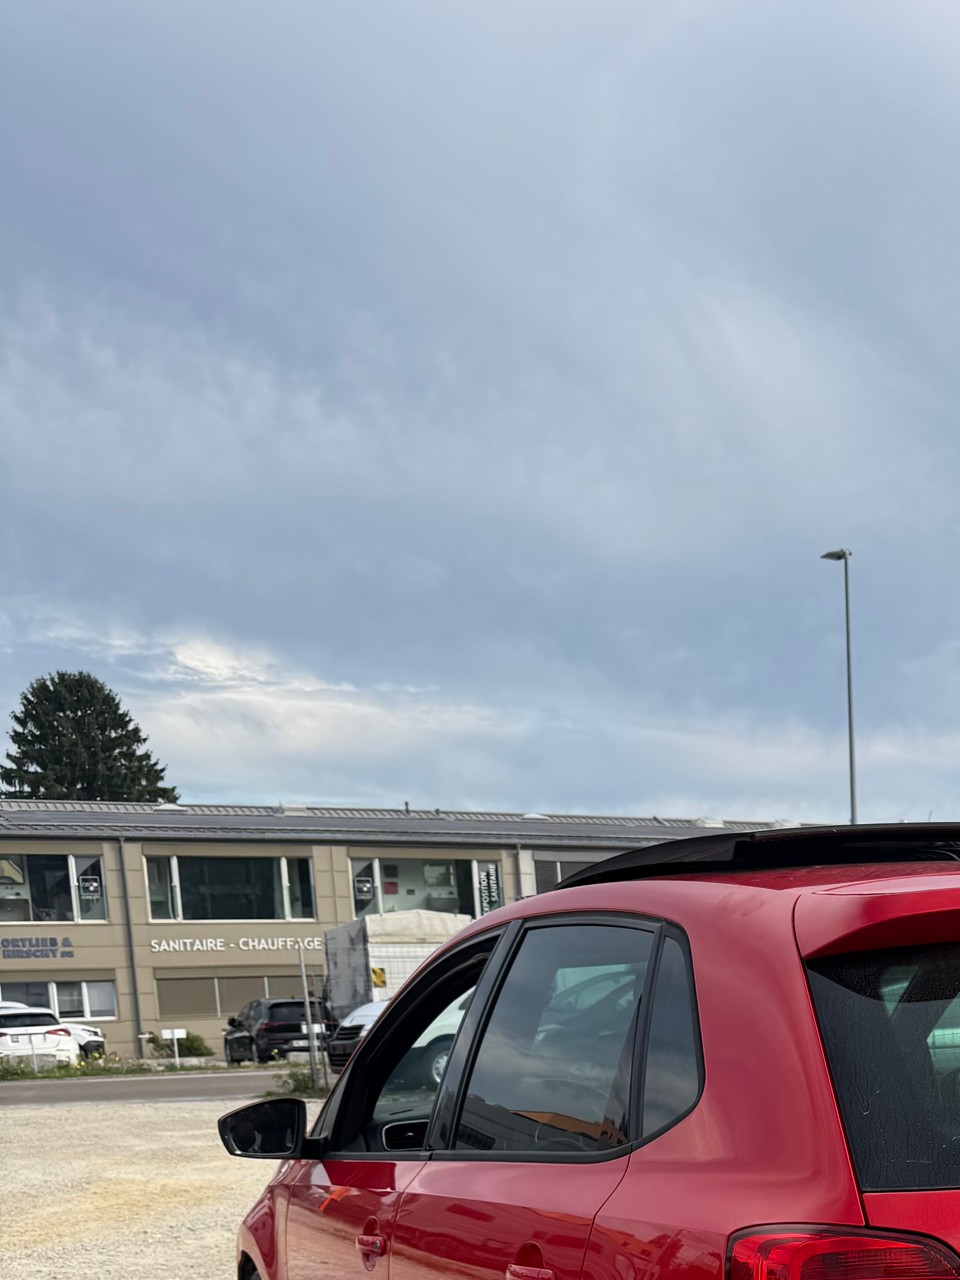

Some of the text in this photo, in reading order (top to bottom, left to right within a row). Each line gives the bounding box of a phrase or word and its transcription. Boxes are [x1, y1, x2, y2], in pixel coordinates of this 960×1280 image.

[488, 863, 499, 902] SANITAIRE
[150, 938, 225, 952] SANITAIRE
[239, 937, 322, 951] CHAUFFAGE
